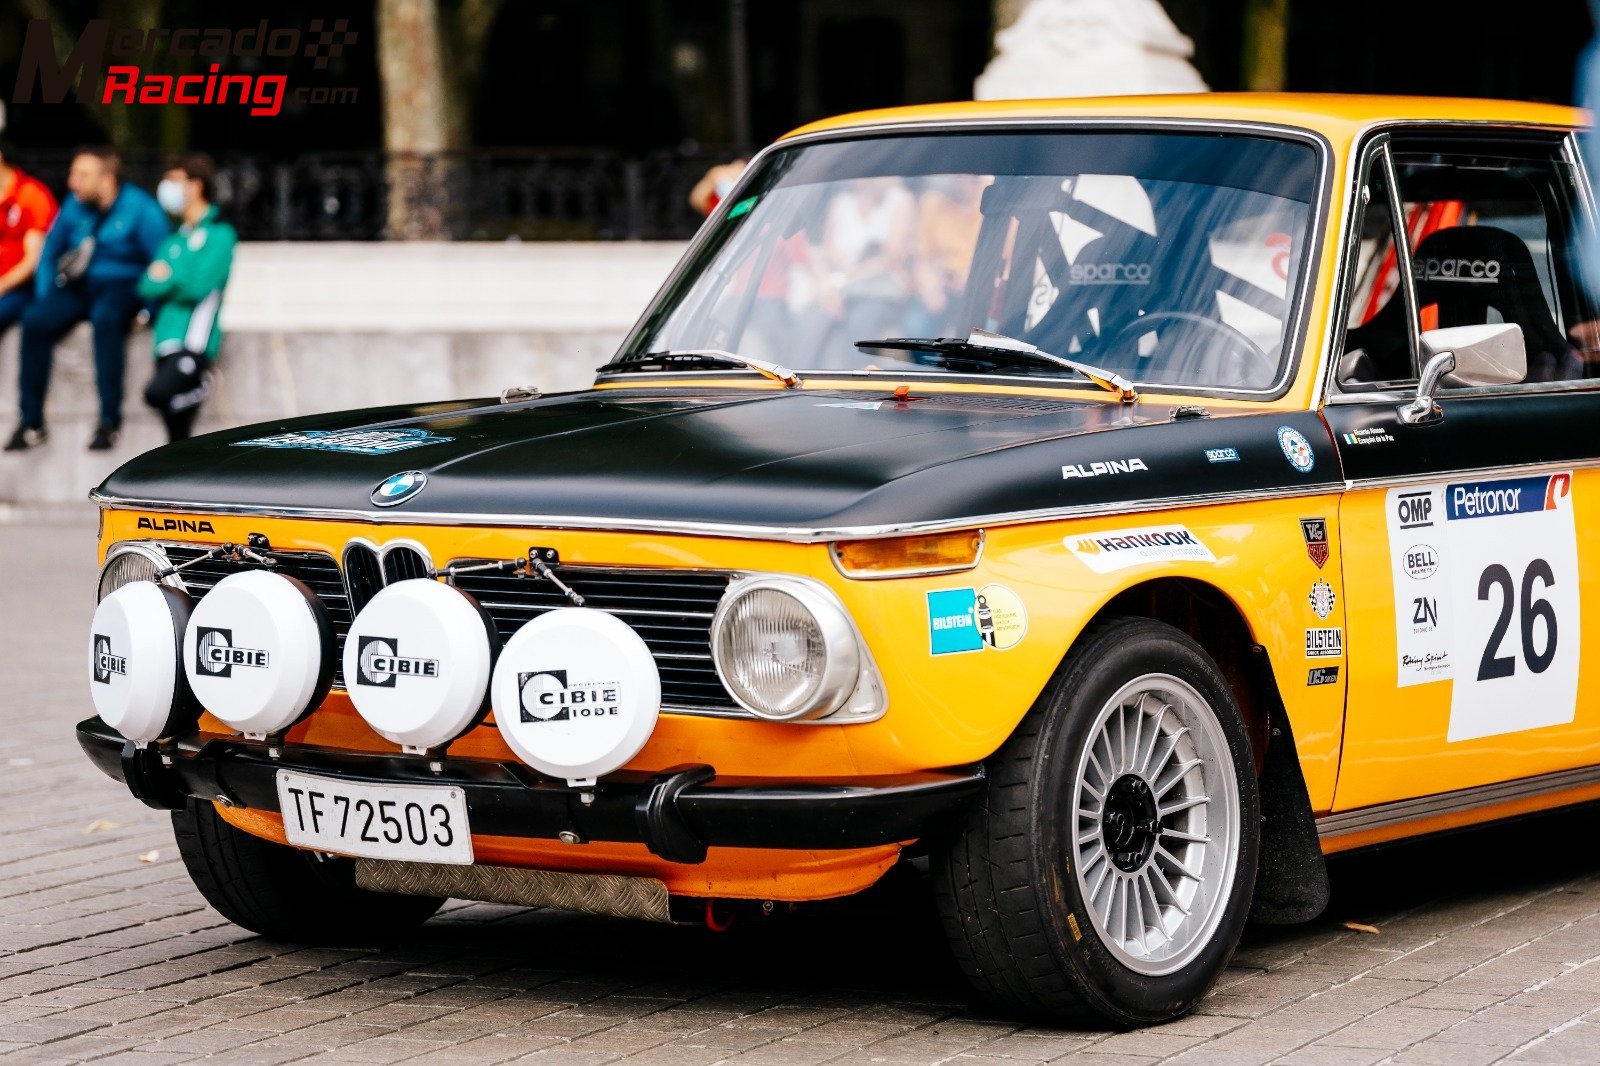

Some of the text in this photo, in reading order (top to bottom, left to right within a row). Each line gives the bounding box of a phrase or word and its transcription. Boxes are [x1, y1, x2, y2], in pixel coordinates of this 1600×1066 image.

[1070, 262, 1151, 285] sparco
[1207, 449, 1235, 460] sparco
[1062, 458, 1148, 479] ALPINA
[1398, 496, 1432, 524] OMP
[1454, 486, 1521, 517] Petronor
[137, 517, 215, 534] ALPINA
[1407, 551, 1435, 569] BELL
[933, 614, 973, 630] BILSTEIN
[1477, 558, 1558, 681] 26
[1306, 630, 1342, 649] BILSTEIN
[572, 706, 618, 718] IODE
